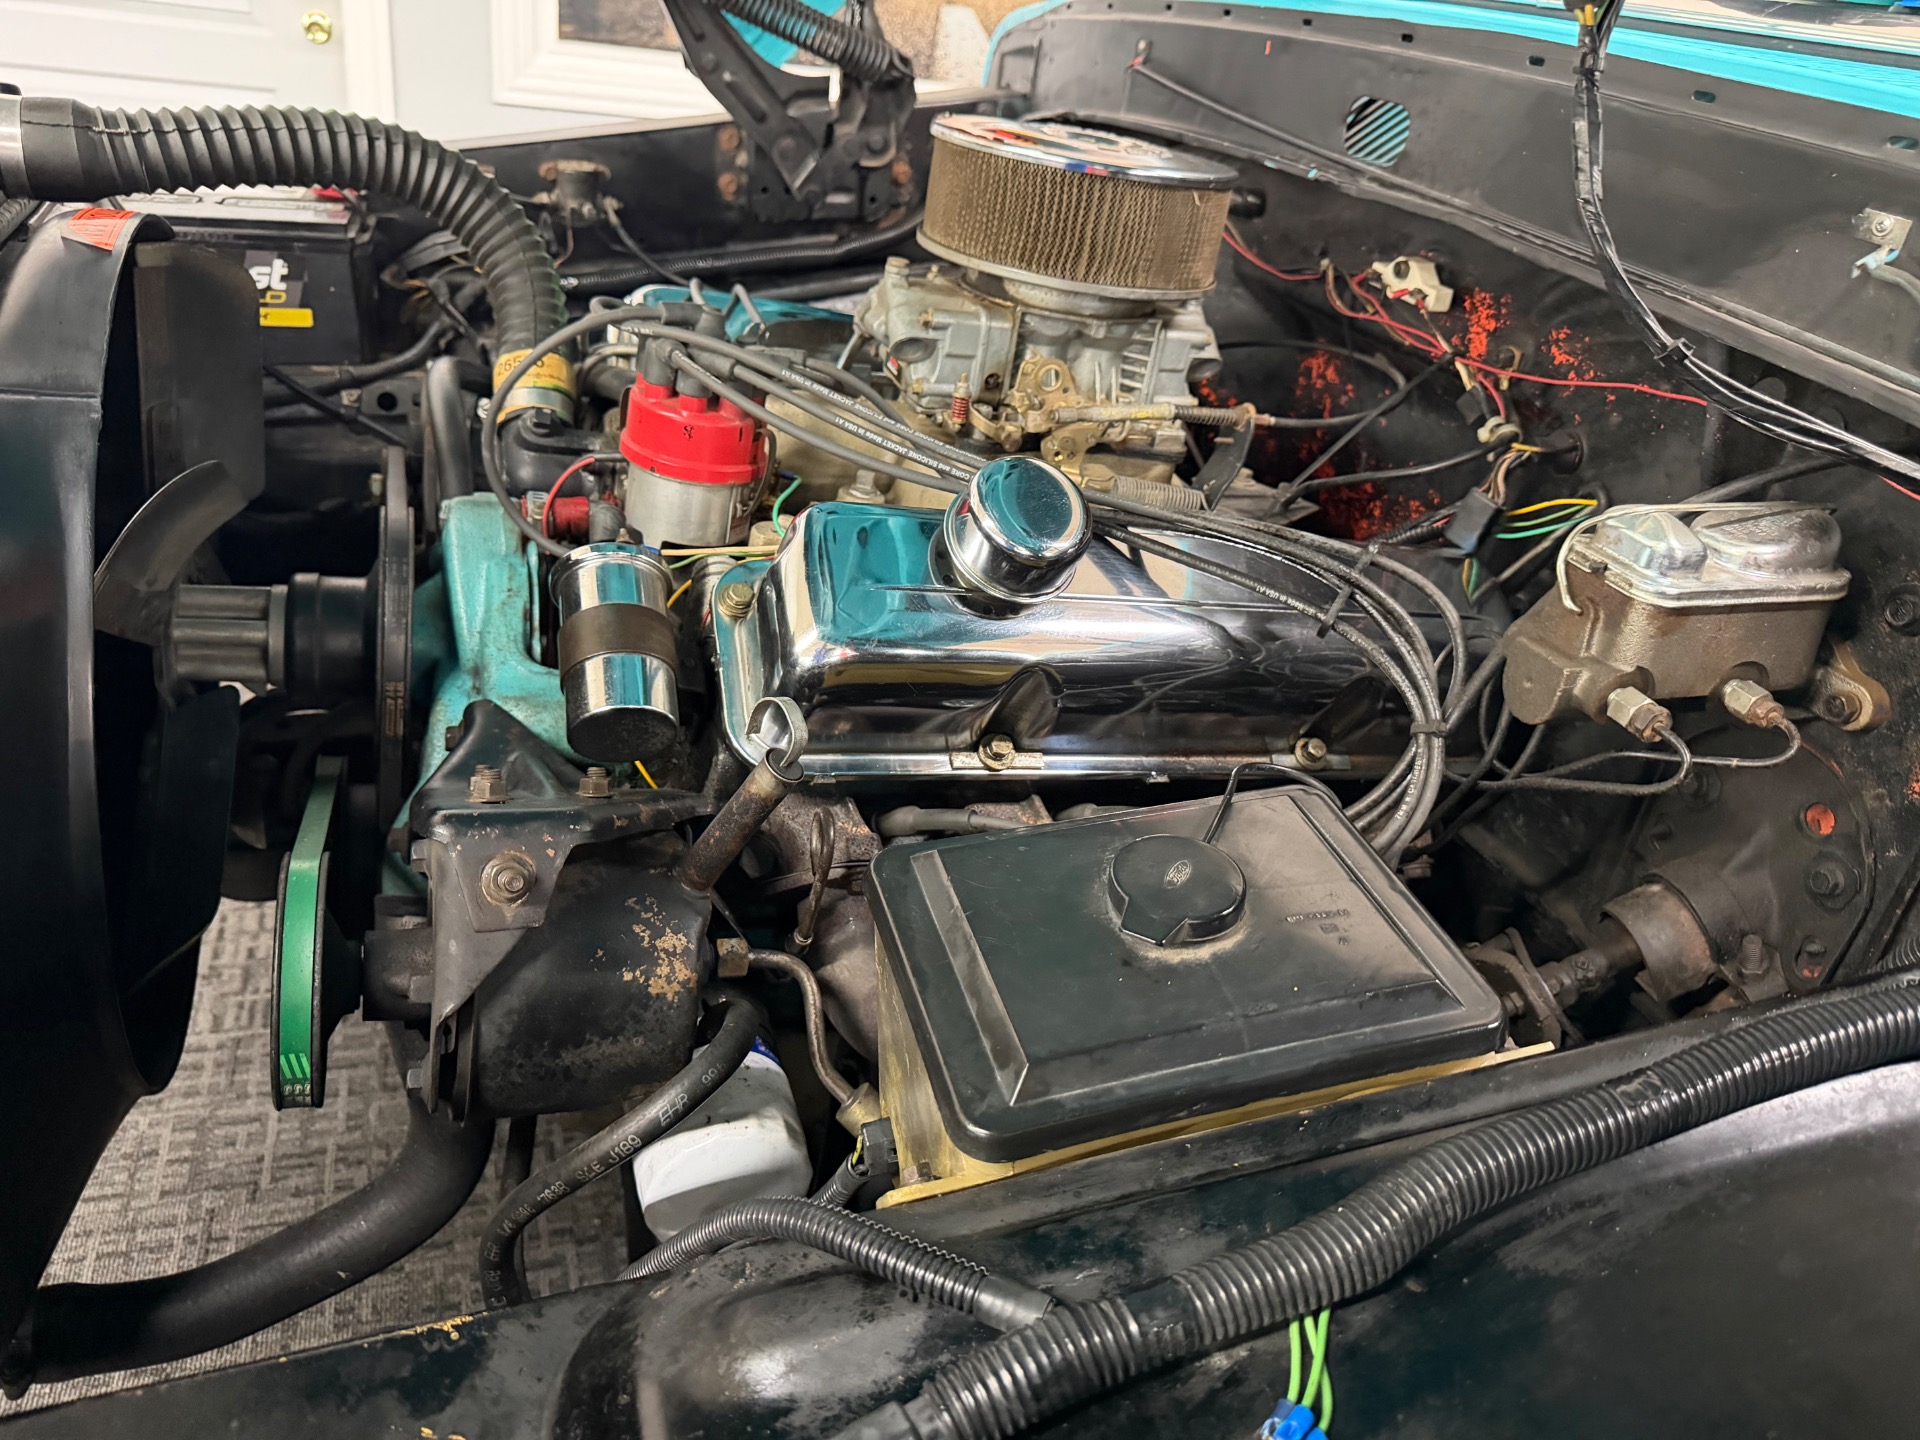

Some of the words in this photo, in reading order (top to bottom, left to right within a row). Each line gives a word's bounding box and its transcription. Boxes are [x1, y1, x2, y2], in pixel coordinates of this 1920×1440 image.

[829, 390, 854, 406] JACKET
[835, 416, 845, 425] A1
[844, 420, 858, 432] USA
[865, 431, 883, 444] Made
[882, 440, 909, 455] JACKET
[908, 451, 939, 468] SILICONE
[938, 463, 951, 472] and
[951, 467, 970, 480] CORE
[1265, 588, 1279, 600] USA
[1166, 862, 1190, 886] Ford
[609, 1134, 642, 1164] J189
